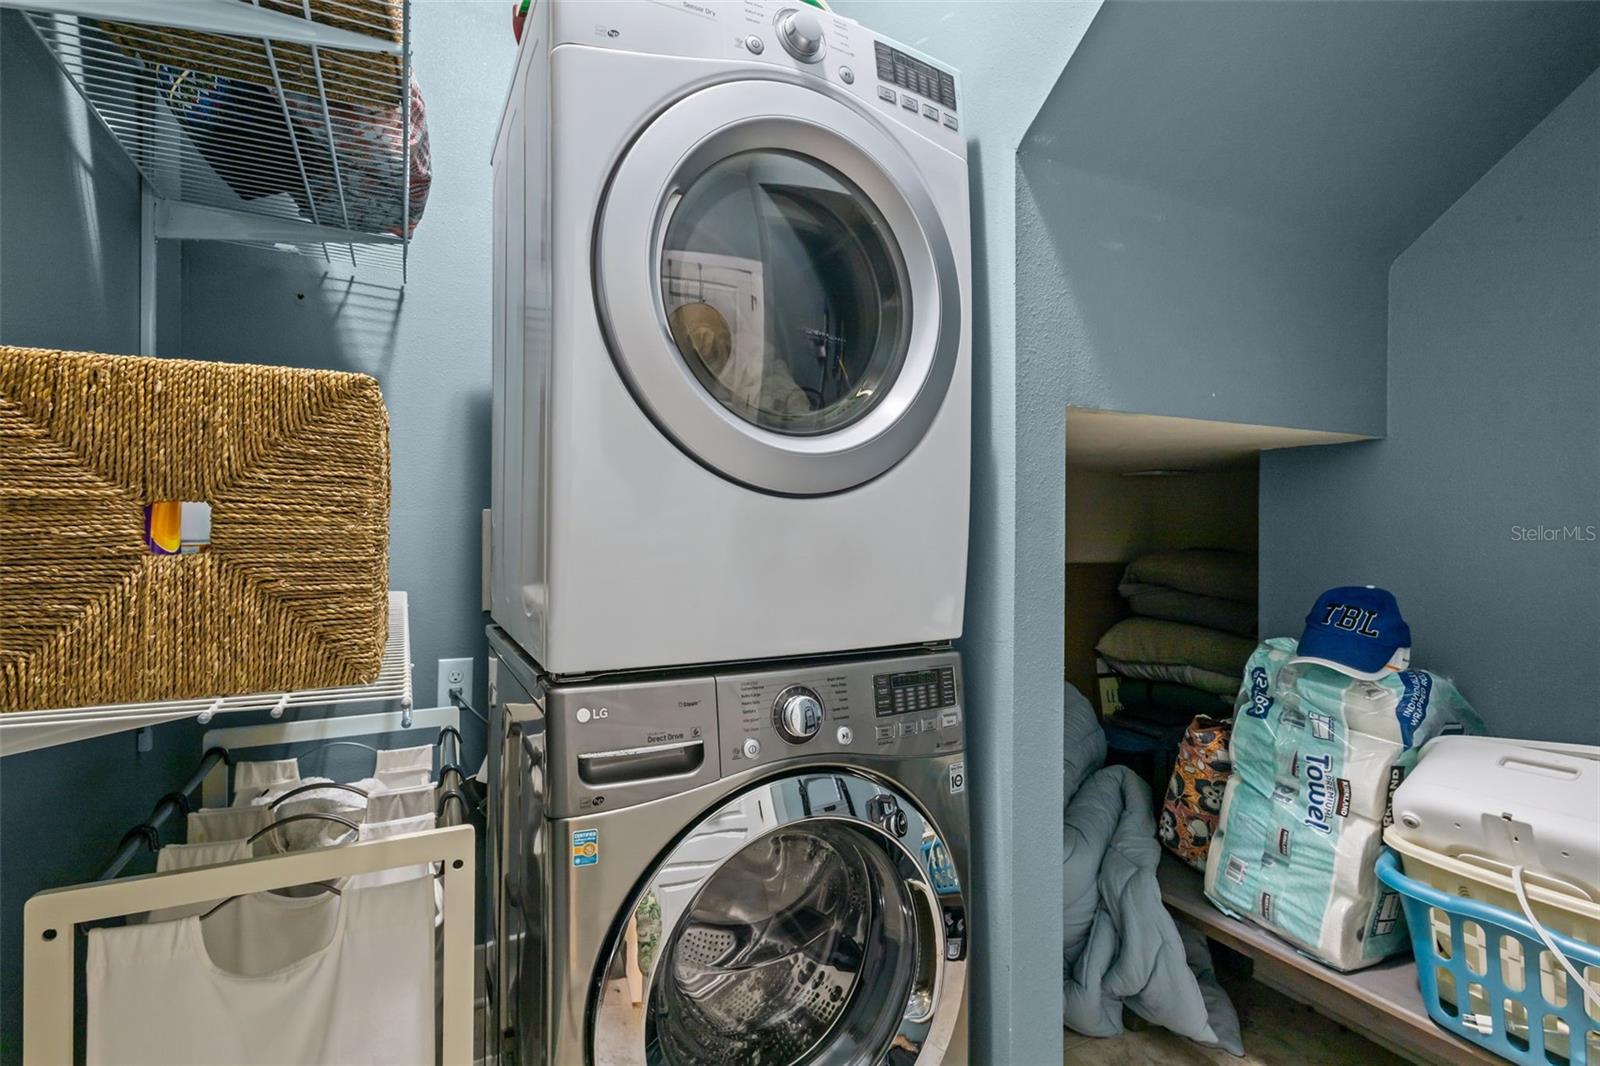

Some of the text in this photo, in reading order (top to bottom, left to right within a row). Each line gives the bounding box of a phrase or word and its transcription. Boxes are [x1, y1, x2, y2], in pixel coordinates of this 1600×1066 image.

[1321, 603, 1380, 639] TBL
[592, 708, 608, 720] LG
[647, 735, 667, 743] Direct
[667, 733, 684, 741] Drive
[1304, 754, 1331, 832] Towel
[1324, 775, 1334, 818] PREMIUM
